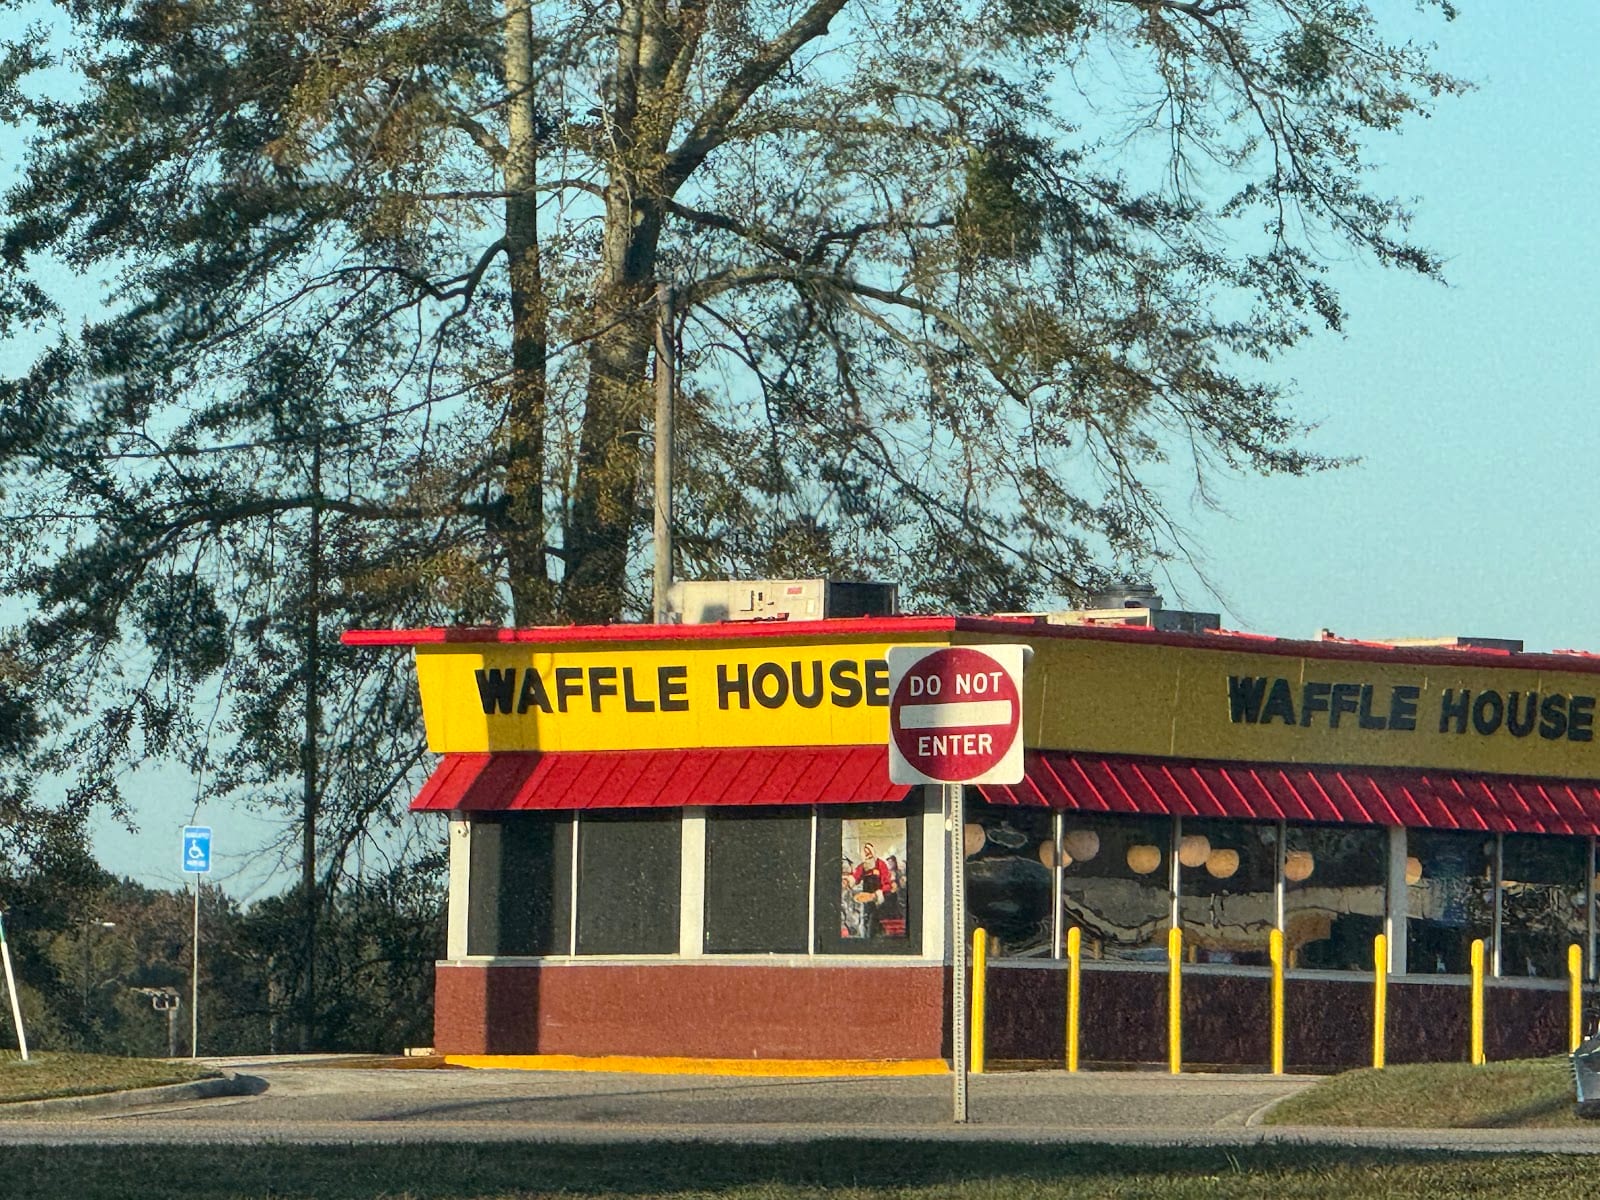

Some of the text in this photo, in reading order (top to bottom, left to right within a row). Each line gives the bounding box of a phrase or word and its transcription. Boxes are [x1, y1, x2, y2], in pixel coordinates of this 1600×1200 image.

[474, 659, 889, 715] WAFFLE HOUSE
[910, 671, 1003, 697] DO NOT
[1226, 675, 1597, 742] WAFFLE HOUSE
[918, 733, 993, 757] ENTER
